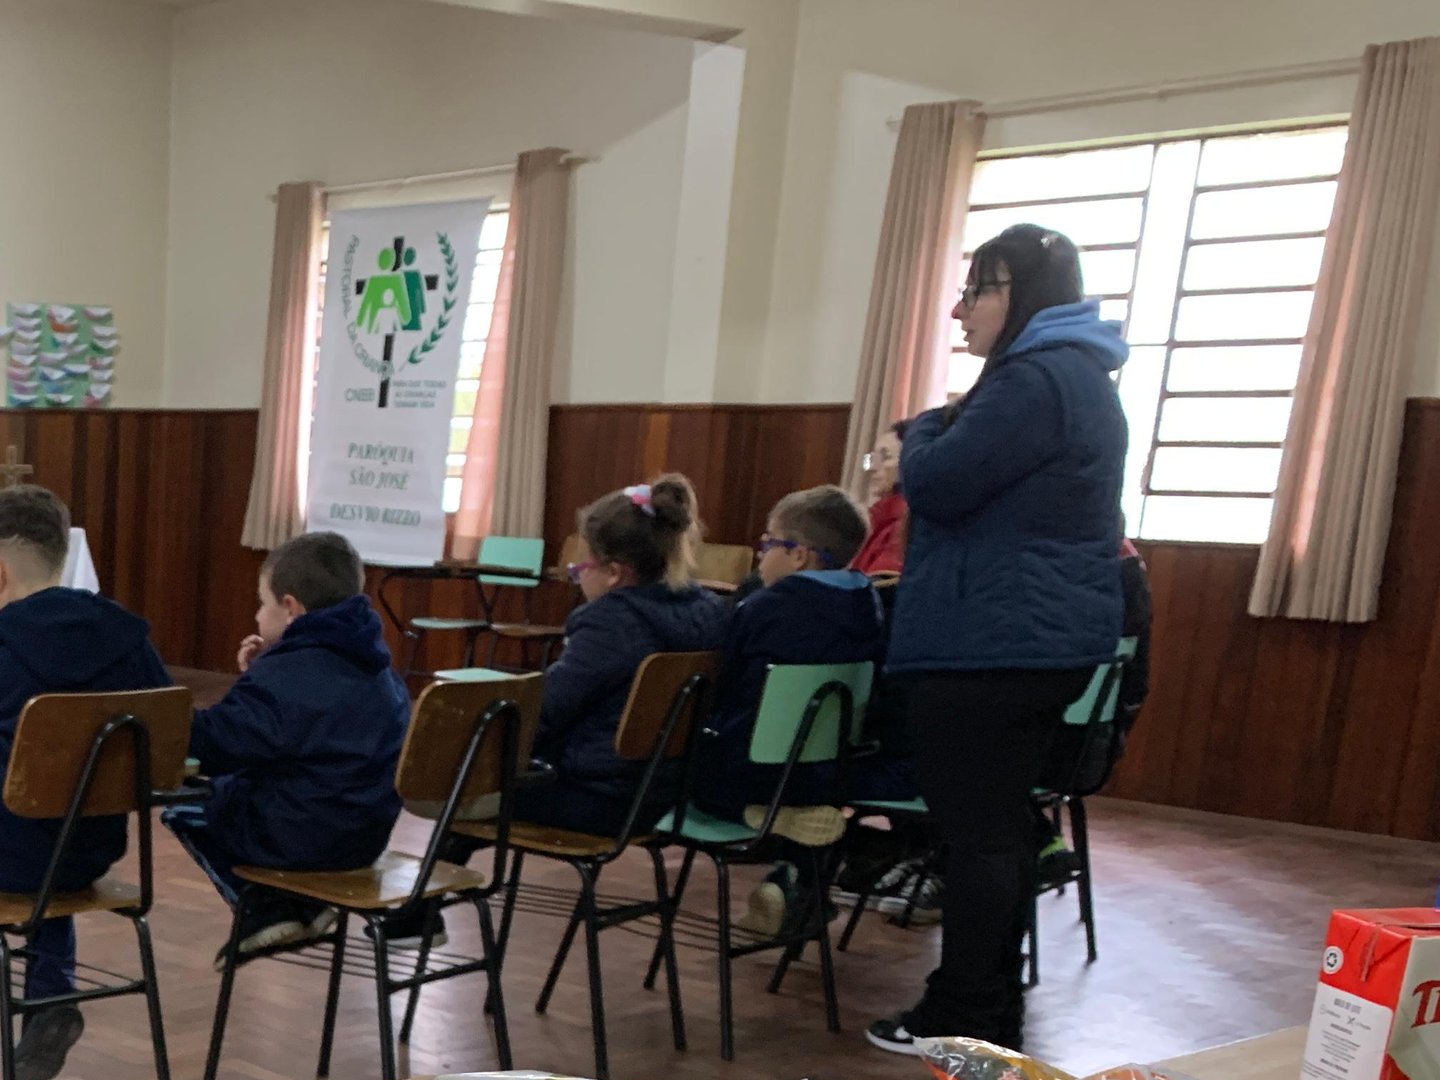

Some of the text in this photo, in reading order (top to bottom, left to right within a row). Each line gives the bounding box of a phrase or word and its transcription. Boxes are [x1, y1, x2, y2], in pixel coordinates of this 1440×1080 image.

[347, 441, 413, 465] PARÓQUIA
[350, 466, 409, 490] SÃO JOSÉ
[330, 503, 380, 522] DESVIO
